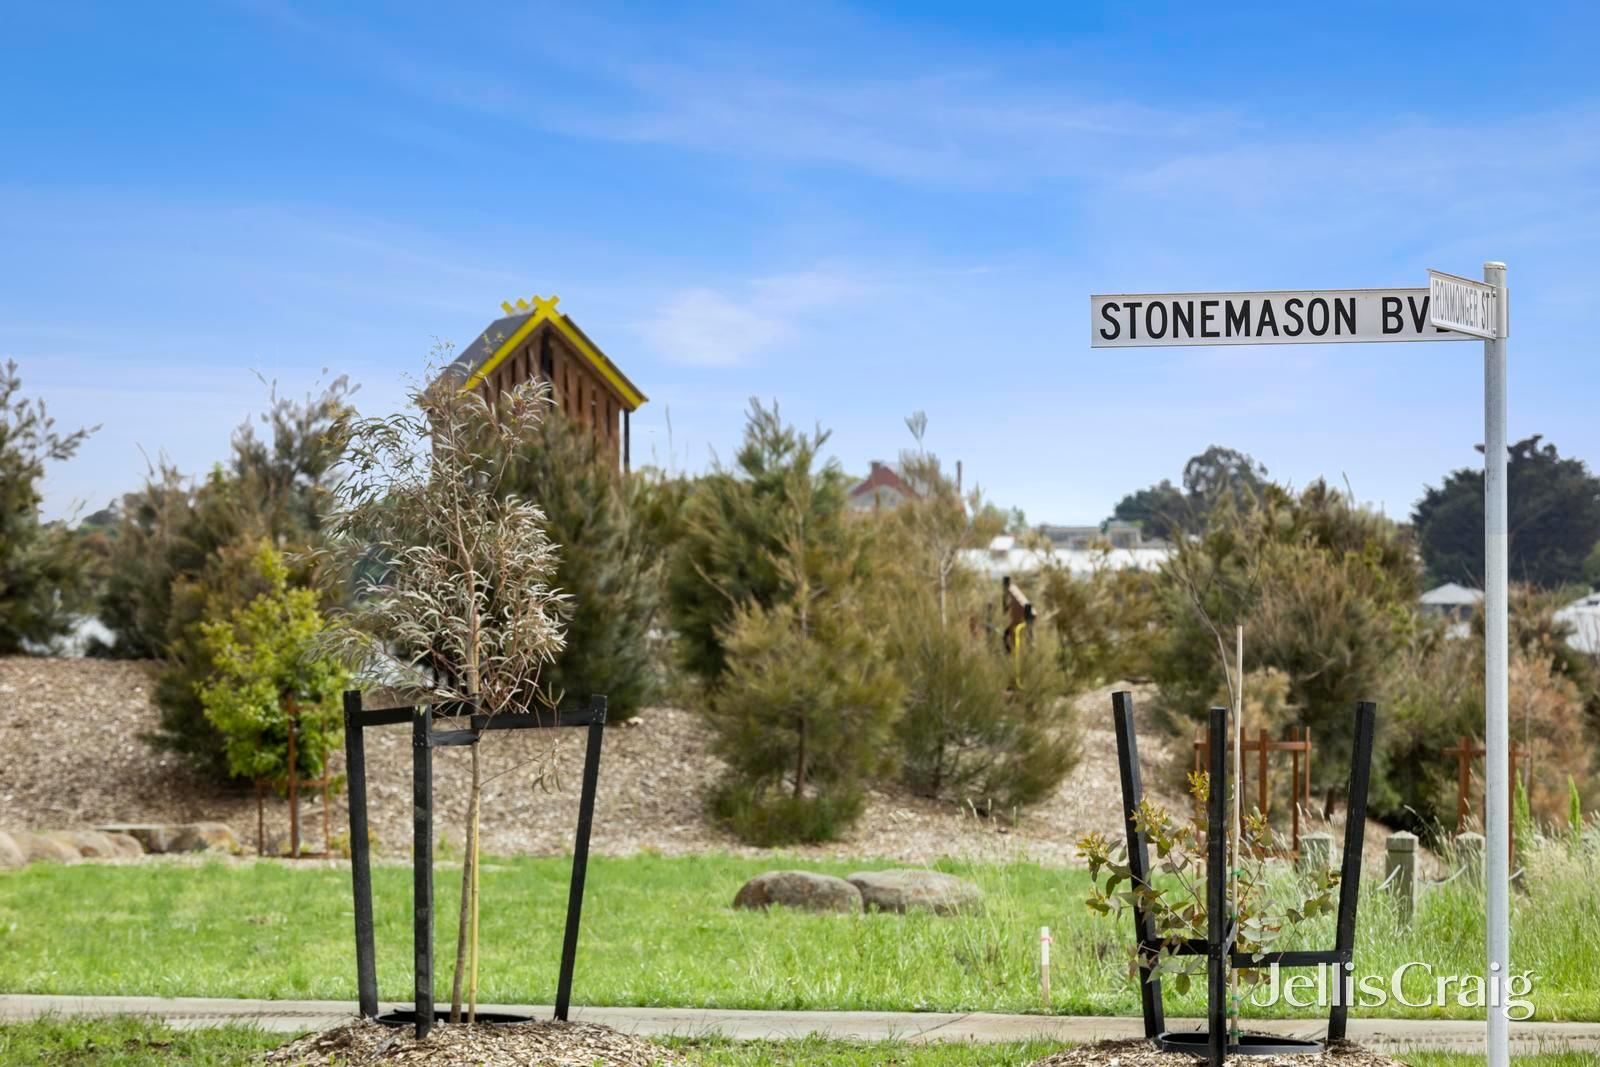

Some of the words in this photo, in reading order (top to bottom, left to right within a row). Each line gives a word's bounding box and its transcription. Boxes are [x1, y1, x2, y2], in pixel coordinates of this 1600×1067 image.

[1100, 297, 1356, 340] STONEMASON
[1382, 295, 1450, 333] BV
[1432, 279, 1478, 328] IRONMONGER
[1481, 290, 1490, 331] ST
